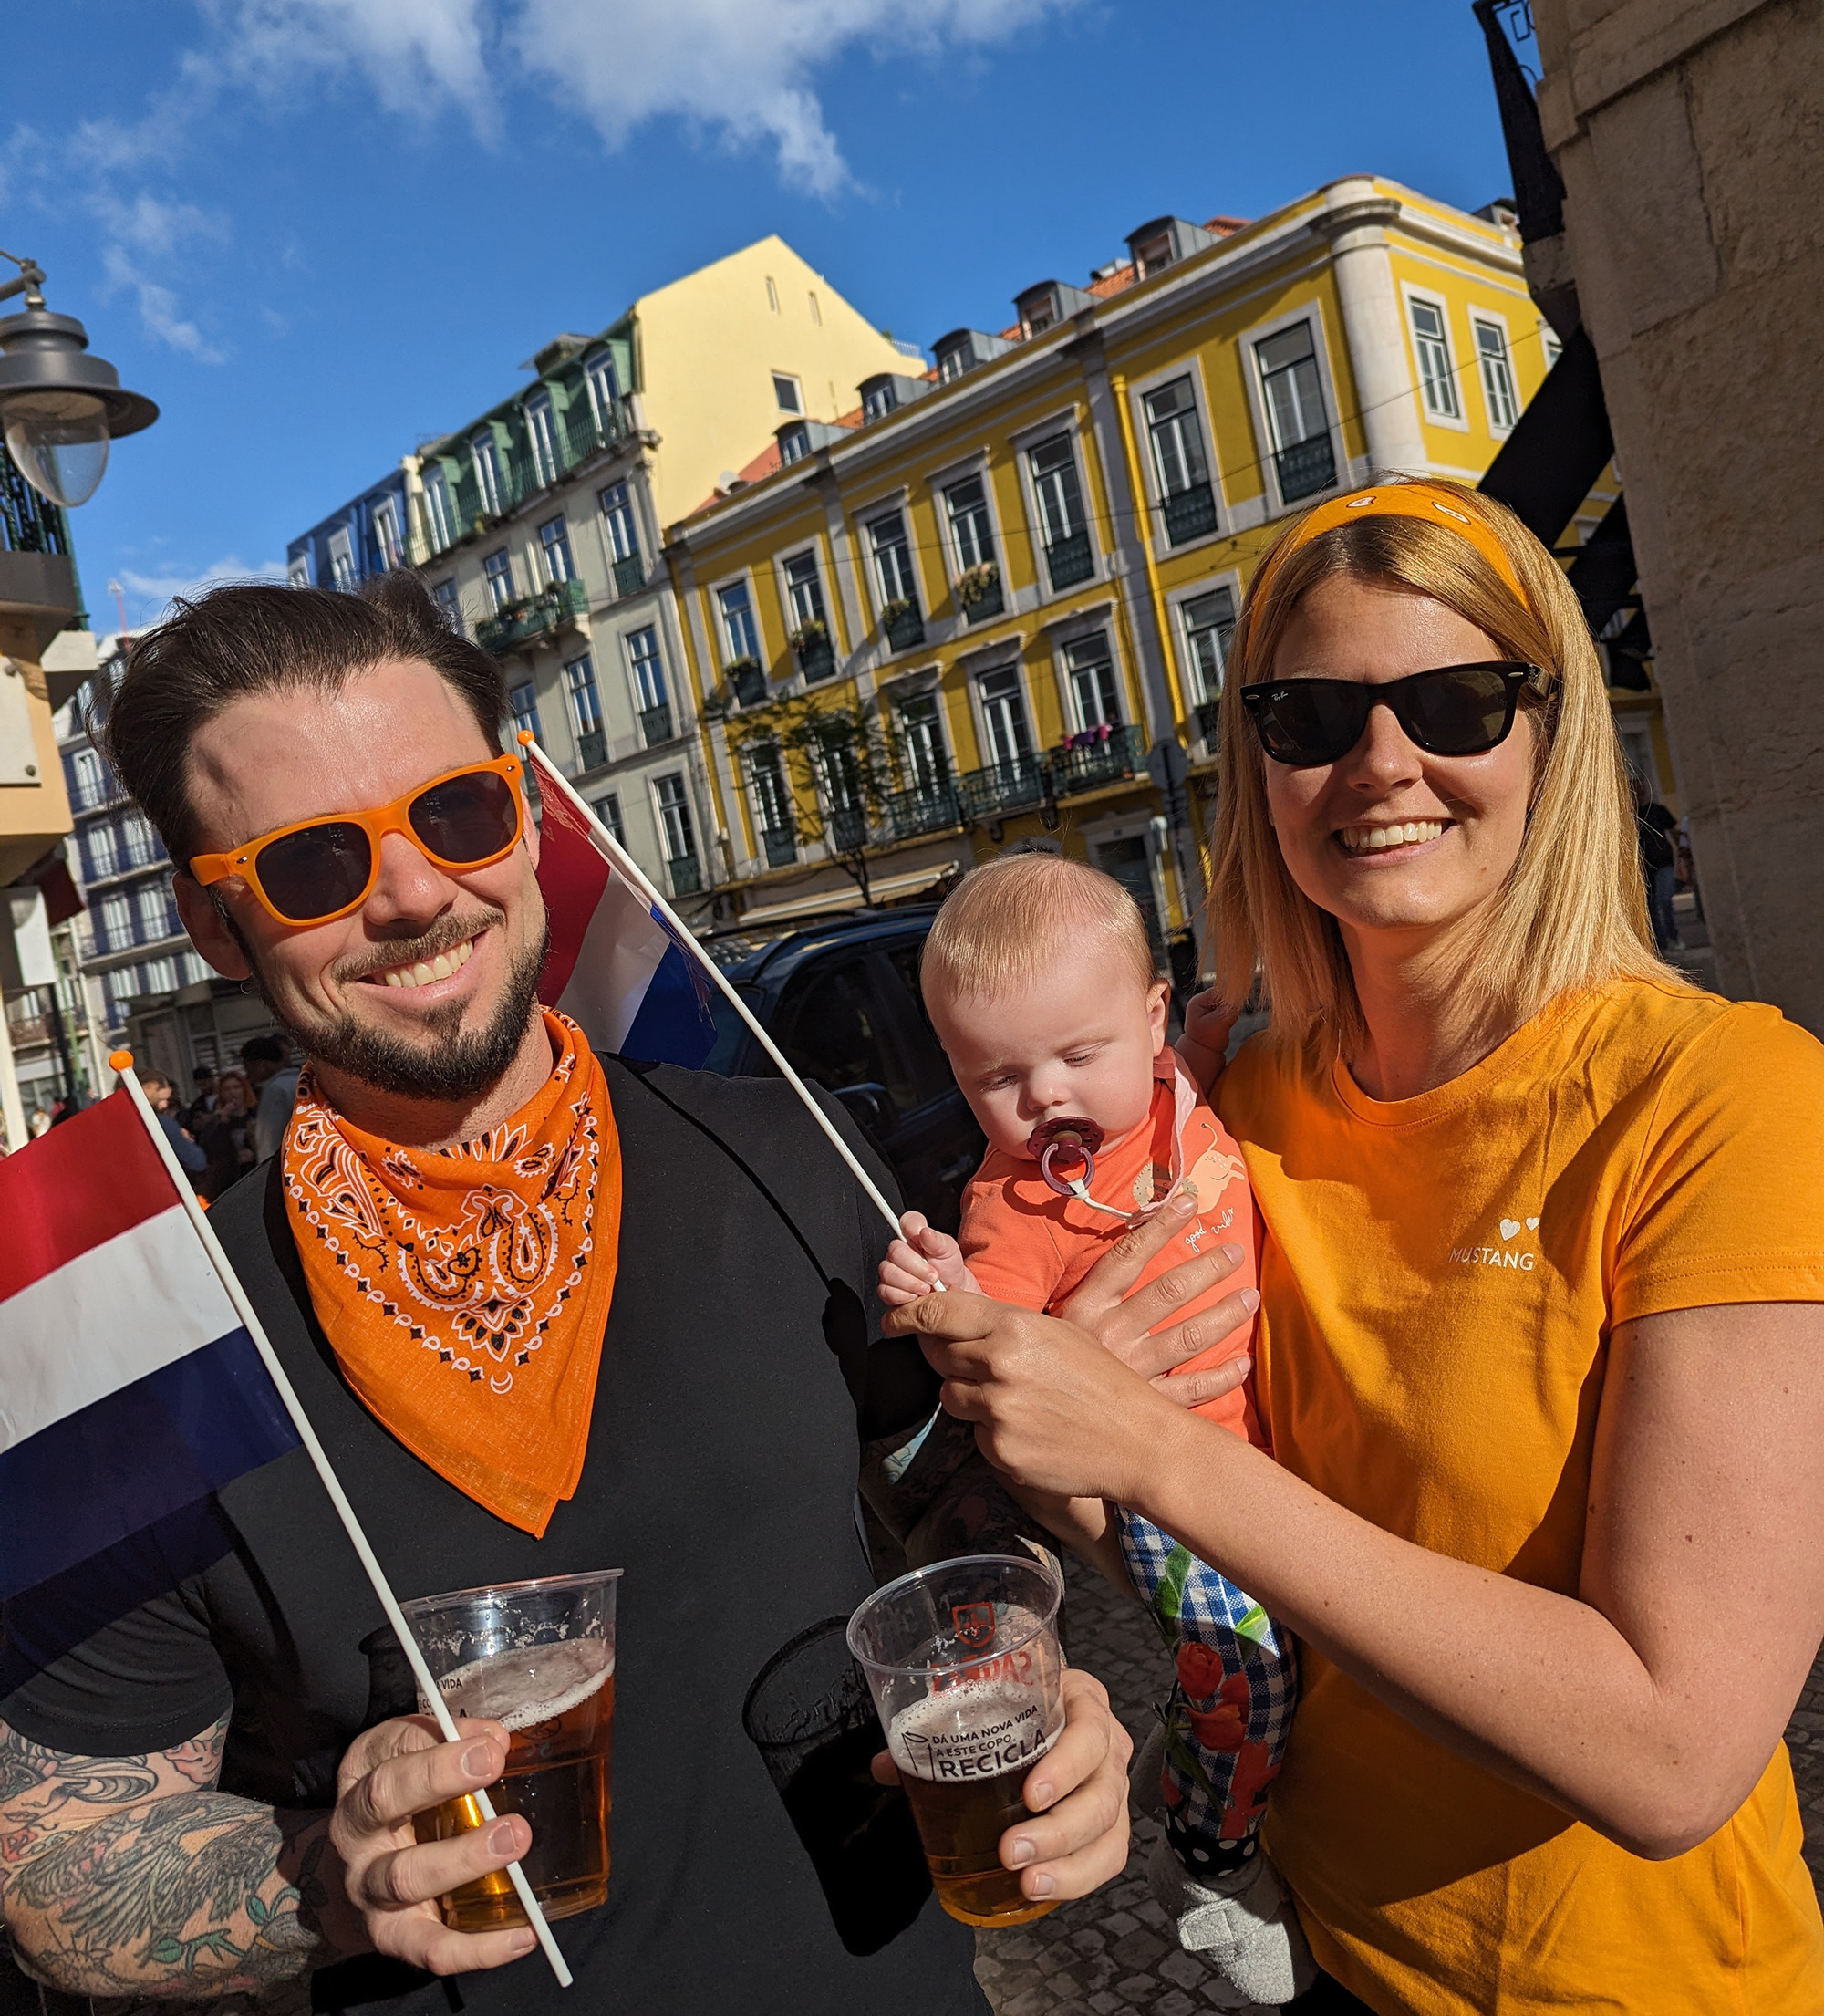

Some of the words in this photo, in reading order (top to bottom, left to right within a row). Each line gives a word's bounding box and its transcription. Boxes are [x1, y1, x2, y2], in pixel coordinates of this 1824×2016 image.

[1185, 1218, 1207, 1253] good
[1448, 1247, 1534, 1271] MUSTANG
[441, 1678, 463, 1690] VIDA
[932, 1734, 948, 1744] DÁ
[951, 1732, 979, 1744] UMA
[981, 1720, 1013, 1739] NOVA
[1014, 1704, 1038, 1724] VIDA
[937, 1748, 944, 1757] A
[947, 1744, 977, 1757] ESTE
[938, 1728, 1047, 1778] RECICLA
